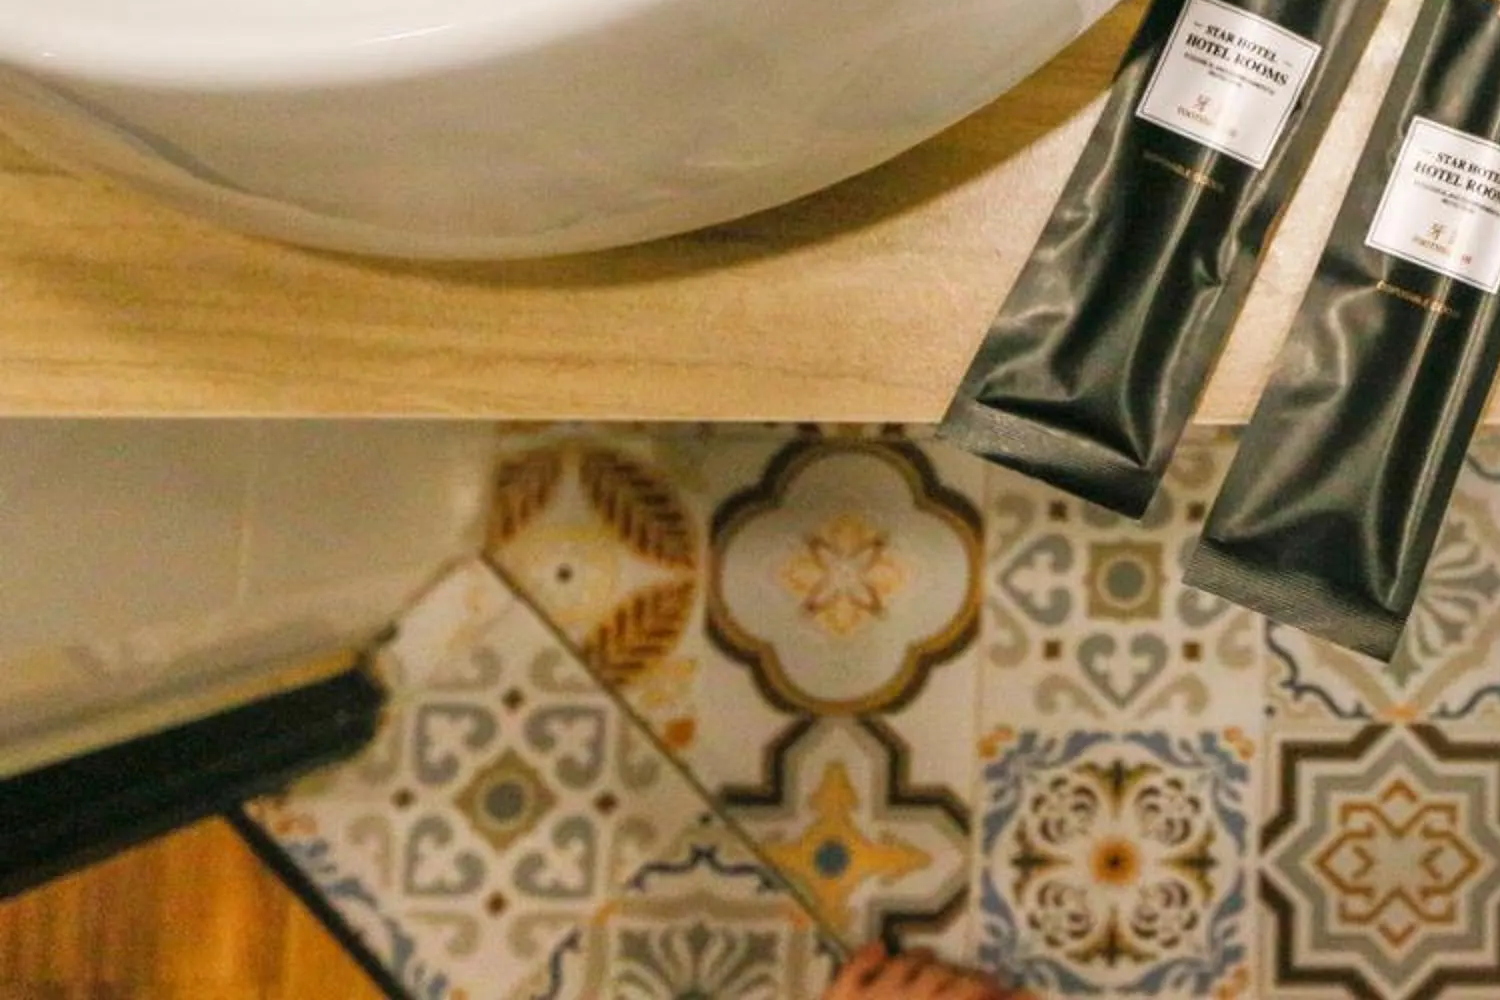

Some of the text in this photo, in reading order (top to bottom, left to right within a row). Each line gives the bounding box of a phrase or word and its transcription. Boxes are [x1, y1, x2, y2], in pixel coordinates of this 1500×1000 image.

[1205, 24, 1278, 62] STAR HOTEL
[1185, 33, 1230, 60] HOTEL
[1234, 52, 1290, 86] ROOMS
[1413, 160, 1464, 187] HOTEL
[1436, 151, 1467, 172] STAR
